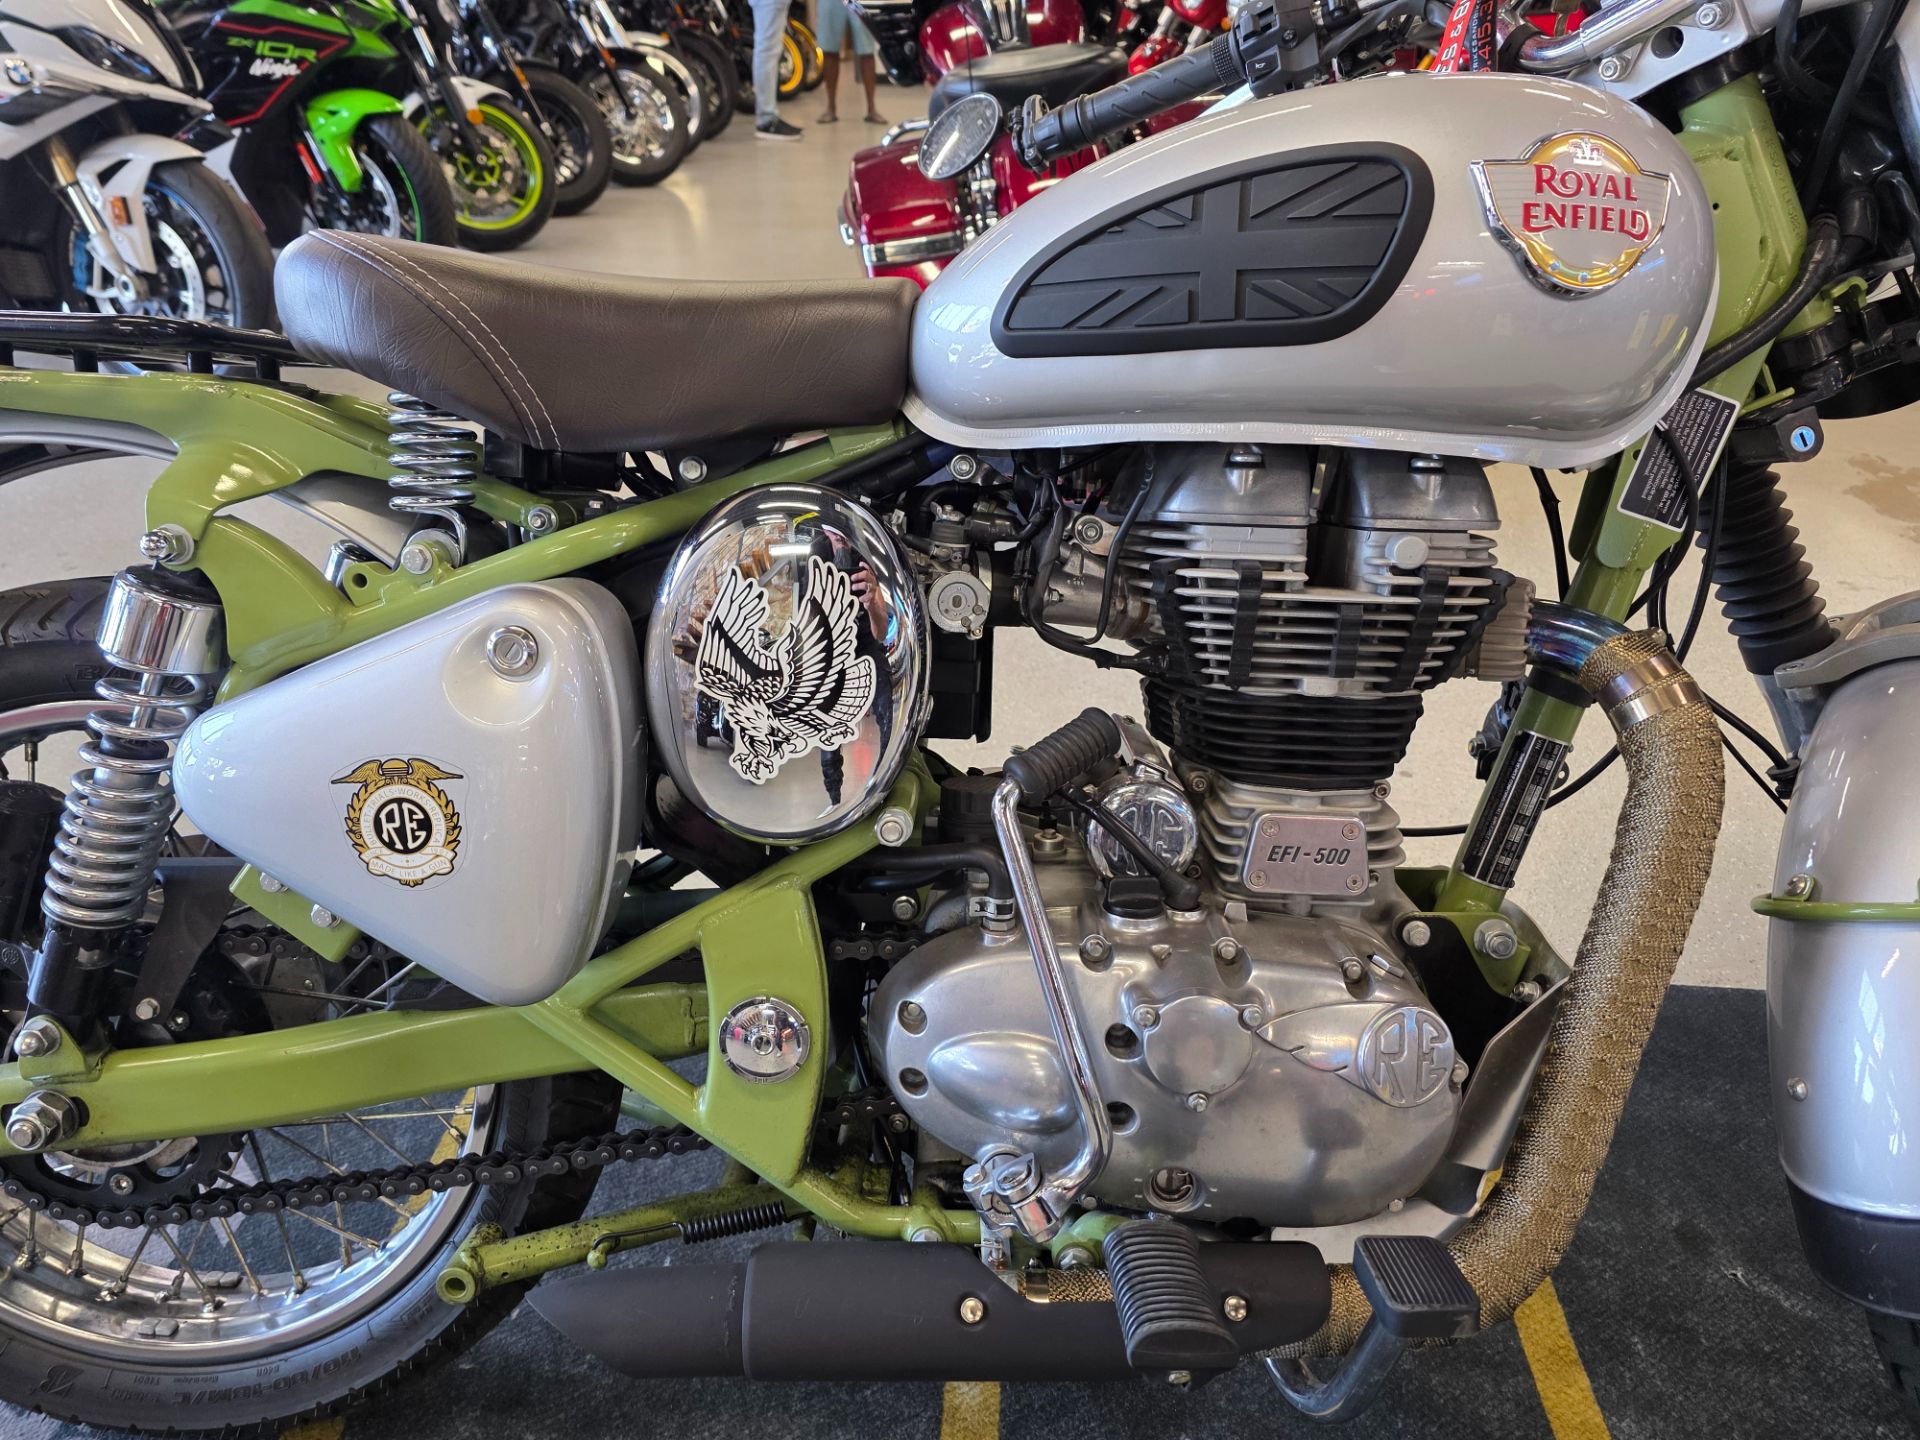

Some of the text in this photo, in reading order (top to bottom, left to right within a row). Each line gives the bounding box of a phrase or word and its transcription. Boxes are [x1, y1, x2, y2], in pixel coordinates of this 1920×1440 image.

[1534, 163, 1639, 203] ROYAL
[1522, 202, 1650, 242] ENFIELD
[1712, 407, 1730, 437] Motorcycle
[379, 802, 427, 850] RE
[371, 860, 395, 875] MADE
[399, 870, 417, 878] LIKE
[429, 860, 447, 871] GUN
[1372, 1010, 1449, 1103] RE
